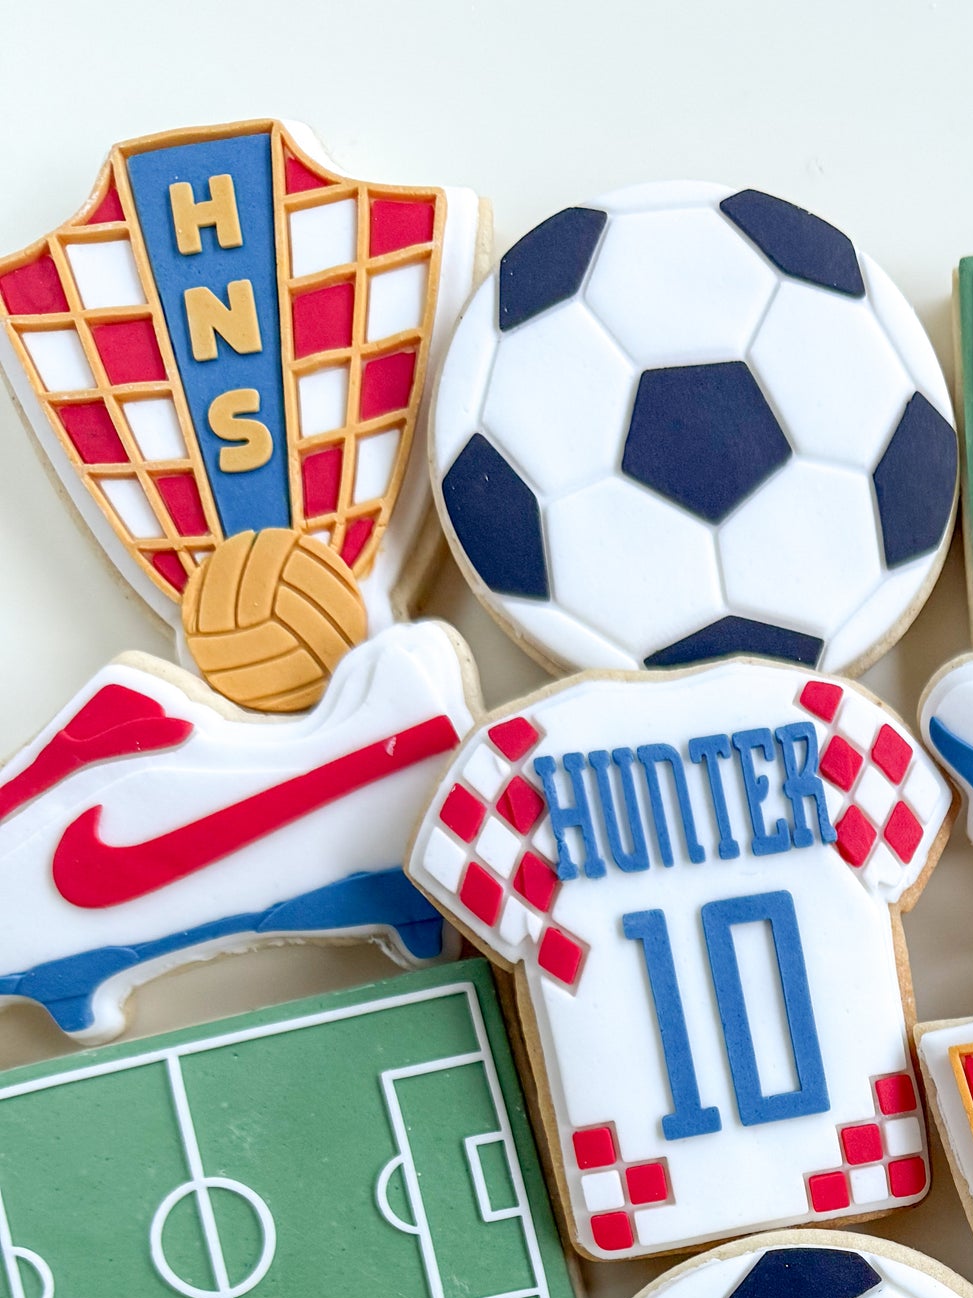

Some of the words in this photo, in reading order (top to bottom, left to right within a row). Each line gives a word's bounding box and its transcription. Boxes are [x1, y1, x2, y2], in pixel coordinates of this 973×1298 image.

[169, 174, 273, 473] HNS
[533, 721, 837, 881] HUNTER
[622, 889, 830, 1141] 10
